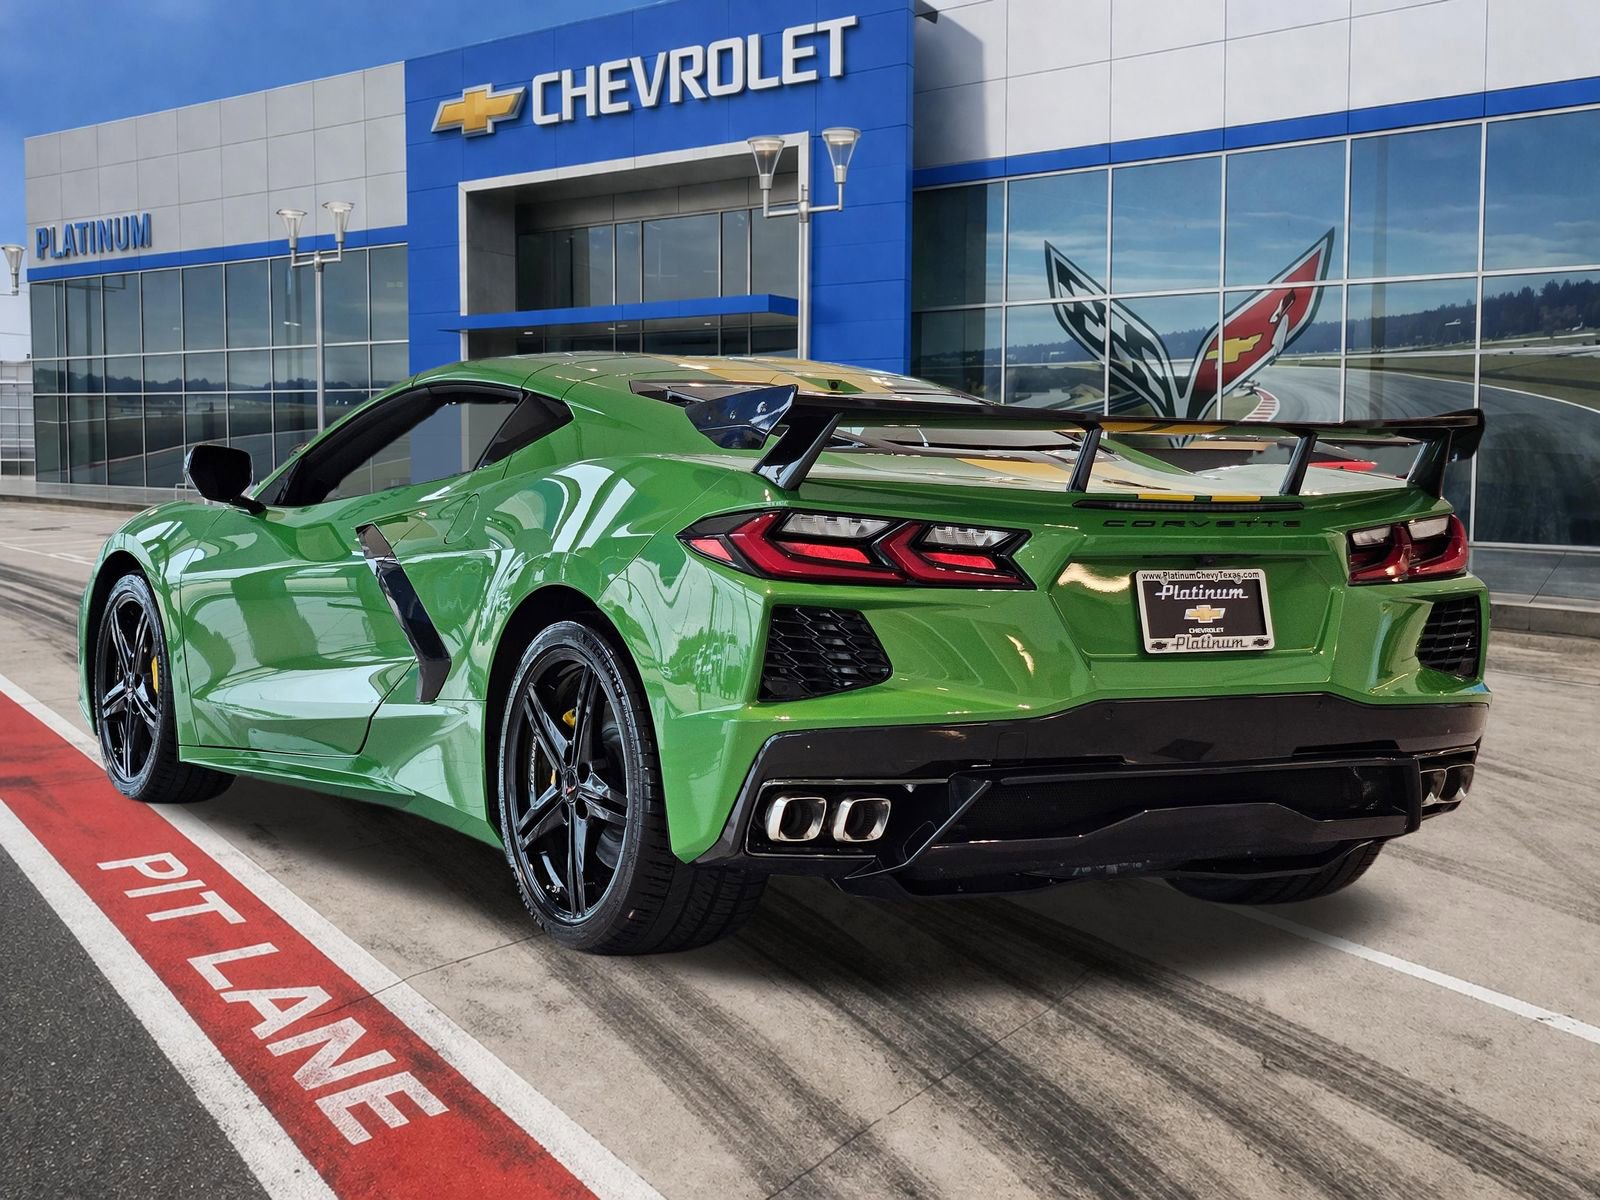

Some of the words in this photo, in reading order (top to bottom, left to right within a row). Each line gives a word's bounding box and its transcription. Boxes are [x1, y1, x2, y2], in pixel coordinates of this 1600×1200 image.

[532, 15, 858, 126] CHEVROLET
[35, 212, 152, 259] PLATINUM
[1102, 520, 1301, 528] CORVETTE
[1142, 571, 1260, 581] www.PlatinumChevyTexas.com
[1155, 584, 1248, 600] Platinum
[1188, 626, 1225, 634] CHEVROLET
[1171, 635, 1248, 650] Platinum
[96, 852, 247, 924] PIT
[186, 942, 450, 1145] LANE
